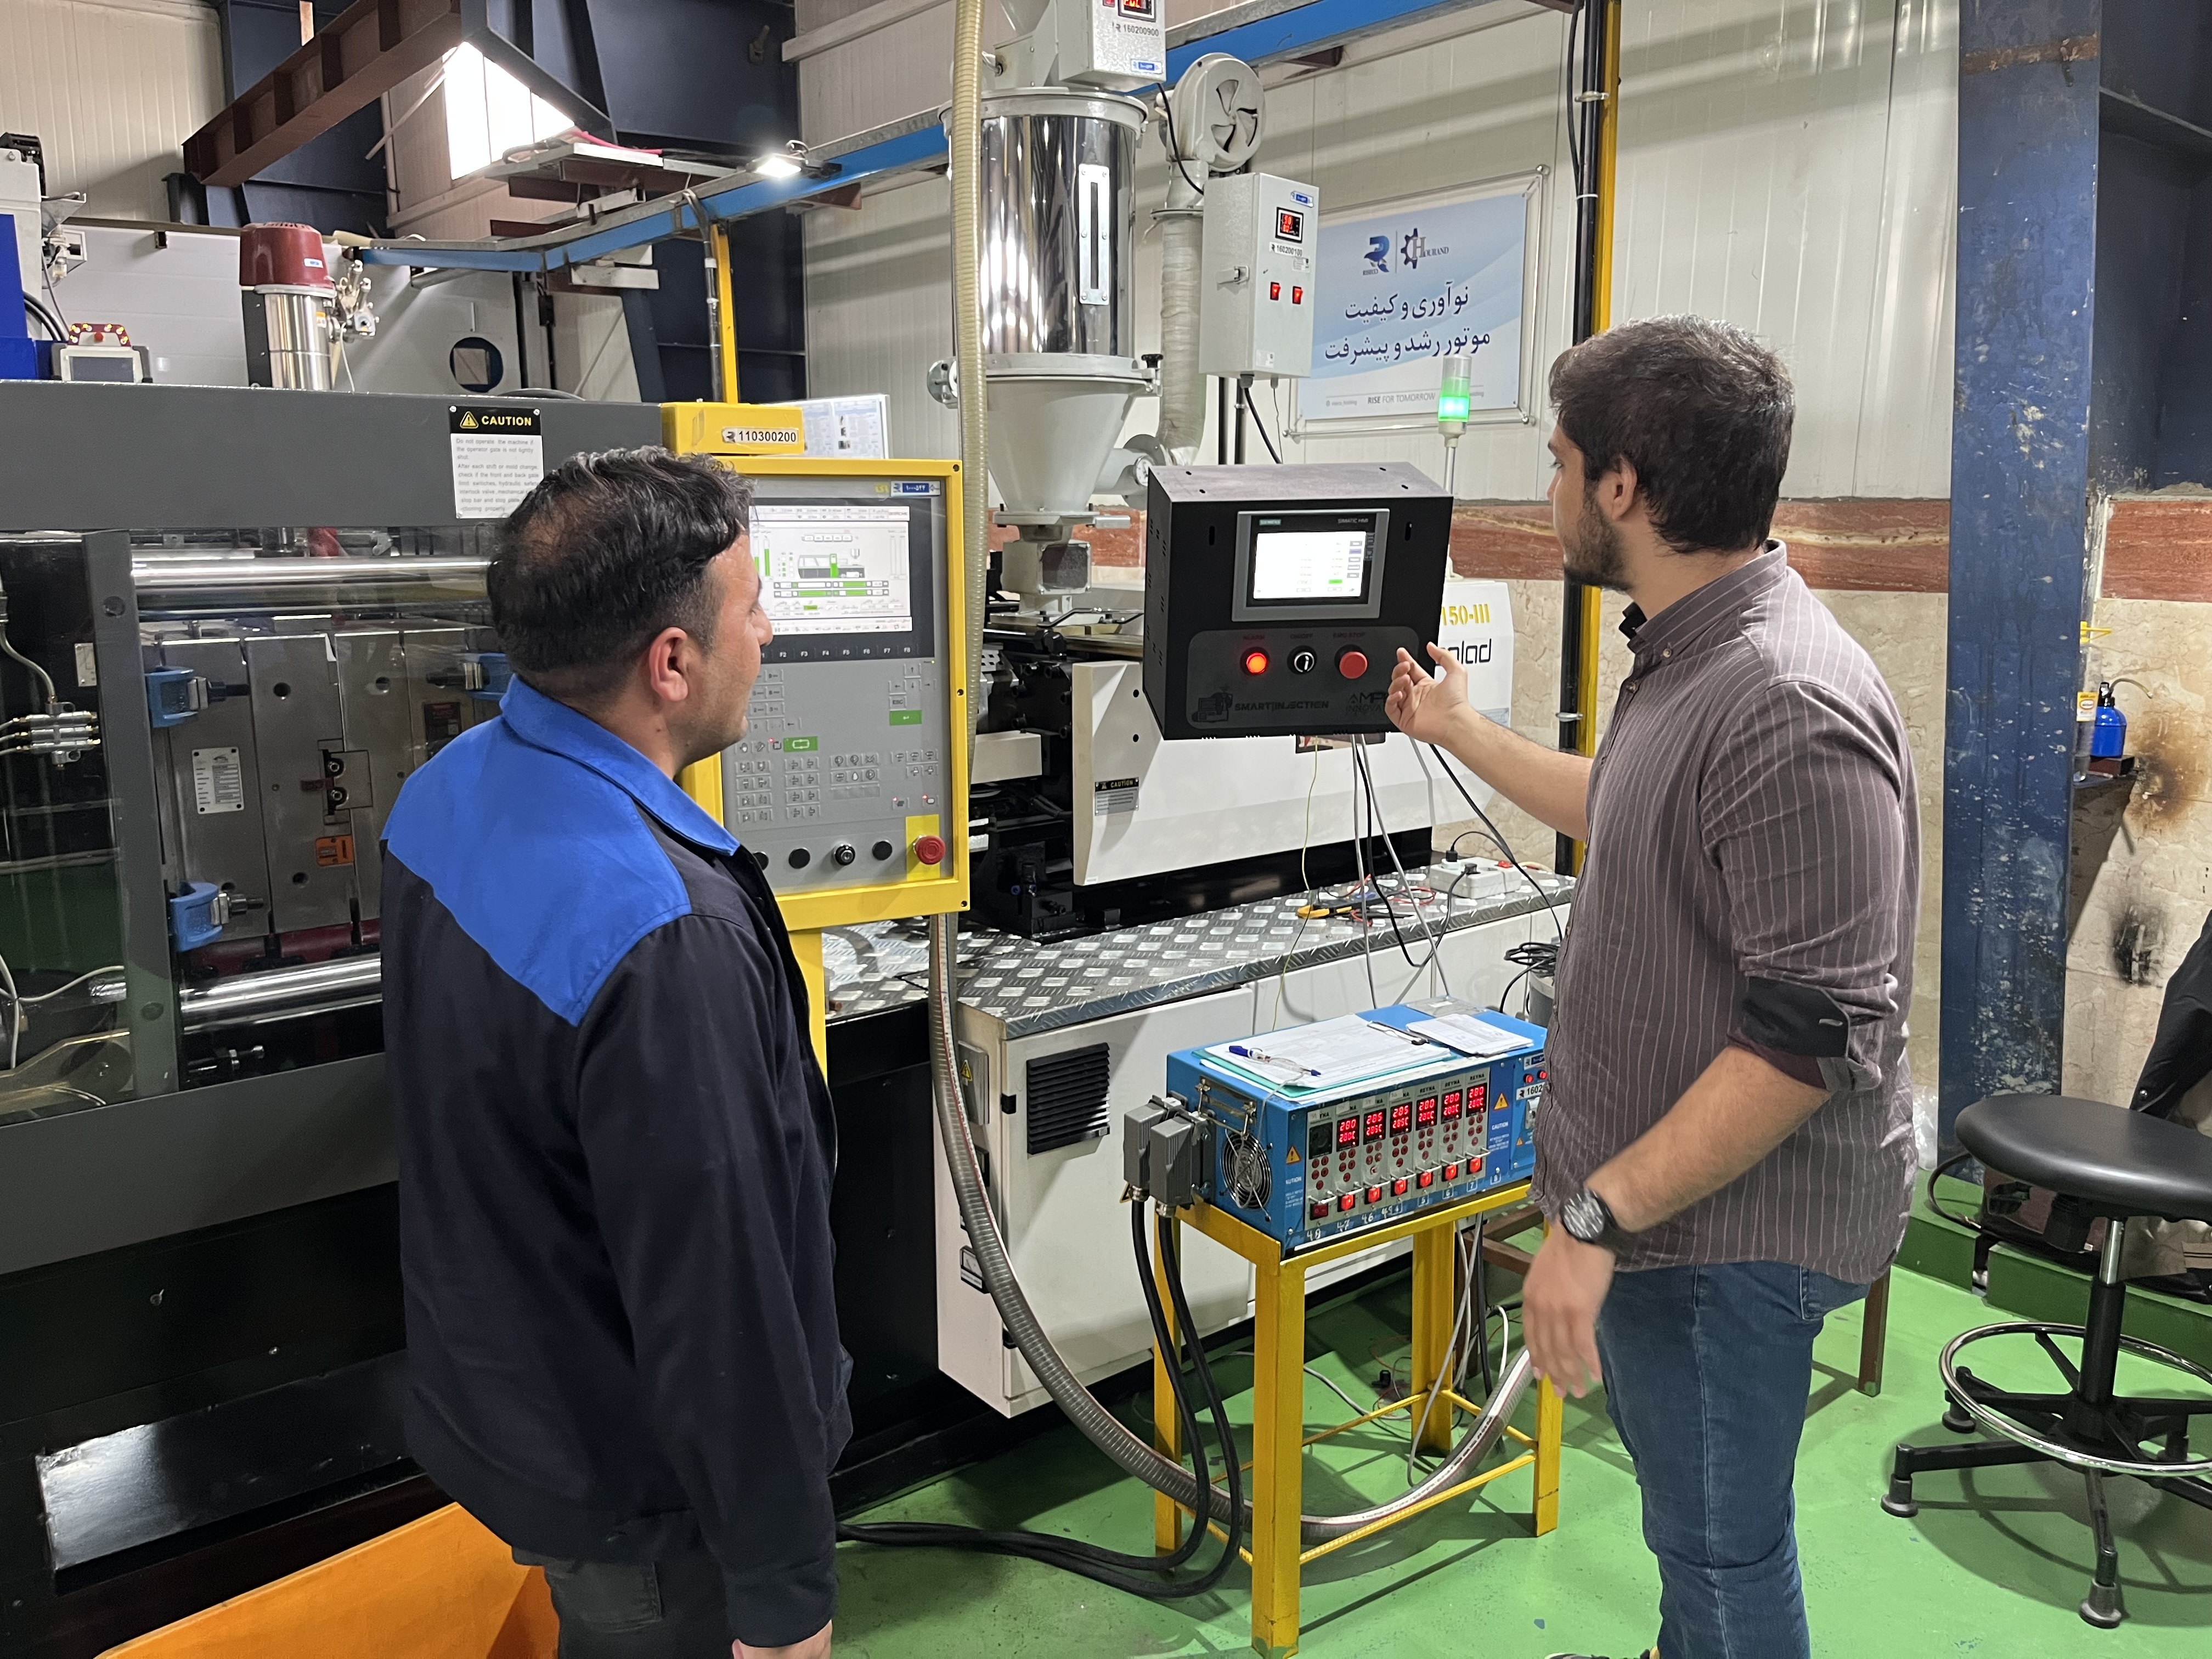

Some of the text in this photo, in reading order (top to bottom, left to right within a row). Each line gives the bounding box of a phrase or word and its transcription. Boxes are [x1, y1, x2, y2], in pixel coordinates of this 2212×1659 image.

[1345, 293, 1398, 323] کیفیت
[1401, 301, 1409, 320] و
[1325, 328, 1490, 365] موتور رشد و پیشرفت
[1396, 393, 1436, 403] TOMORROW
[481, 416, 532, 426] CAUTION
[738, 430, 797, 443] 110300200
[1110, 779, 1133, 788] CAUTION
[1419, 1085, 1435, 1093] REYNA
[1469, 1086, 1485, 1098] 280
[1419, 1098, 1435, 1111] 280
[1444, 1092, 1460, 1105] 280
[1392, 1105, 1409, 1118] 285
[1366, 1112, 1383, 1125] 285
[1340, 1119, 1356, 1132] 280
[1307, 1228, 1321, 1241] 48
